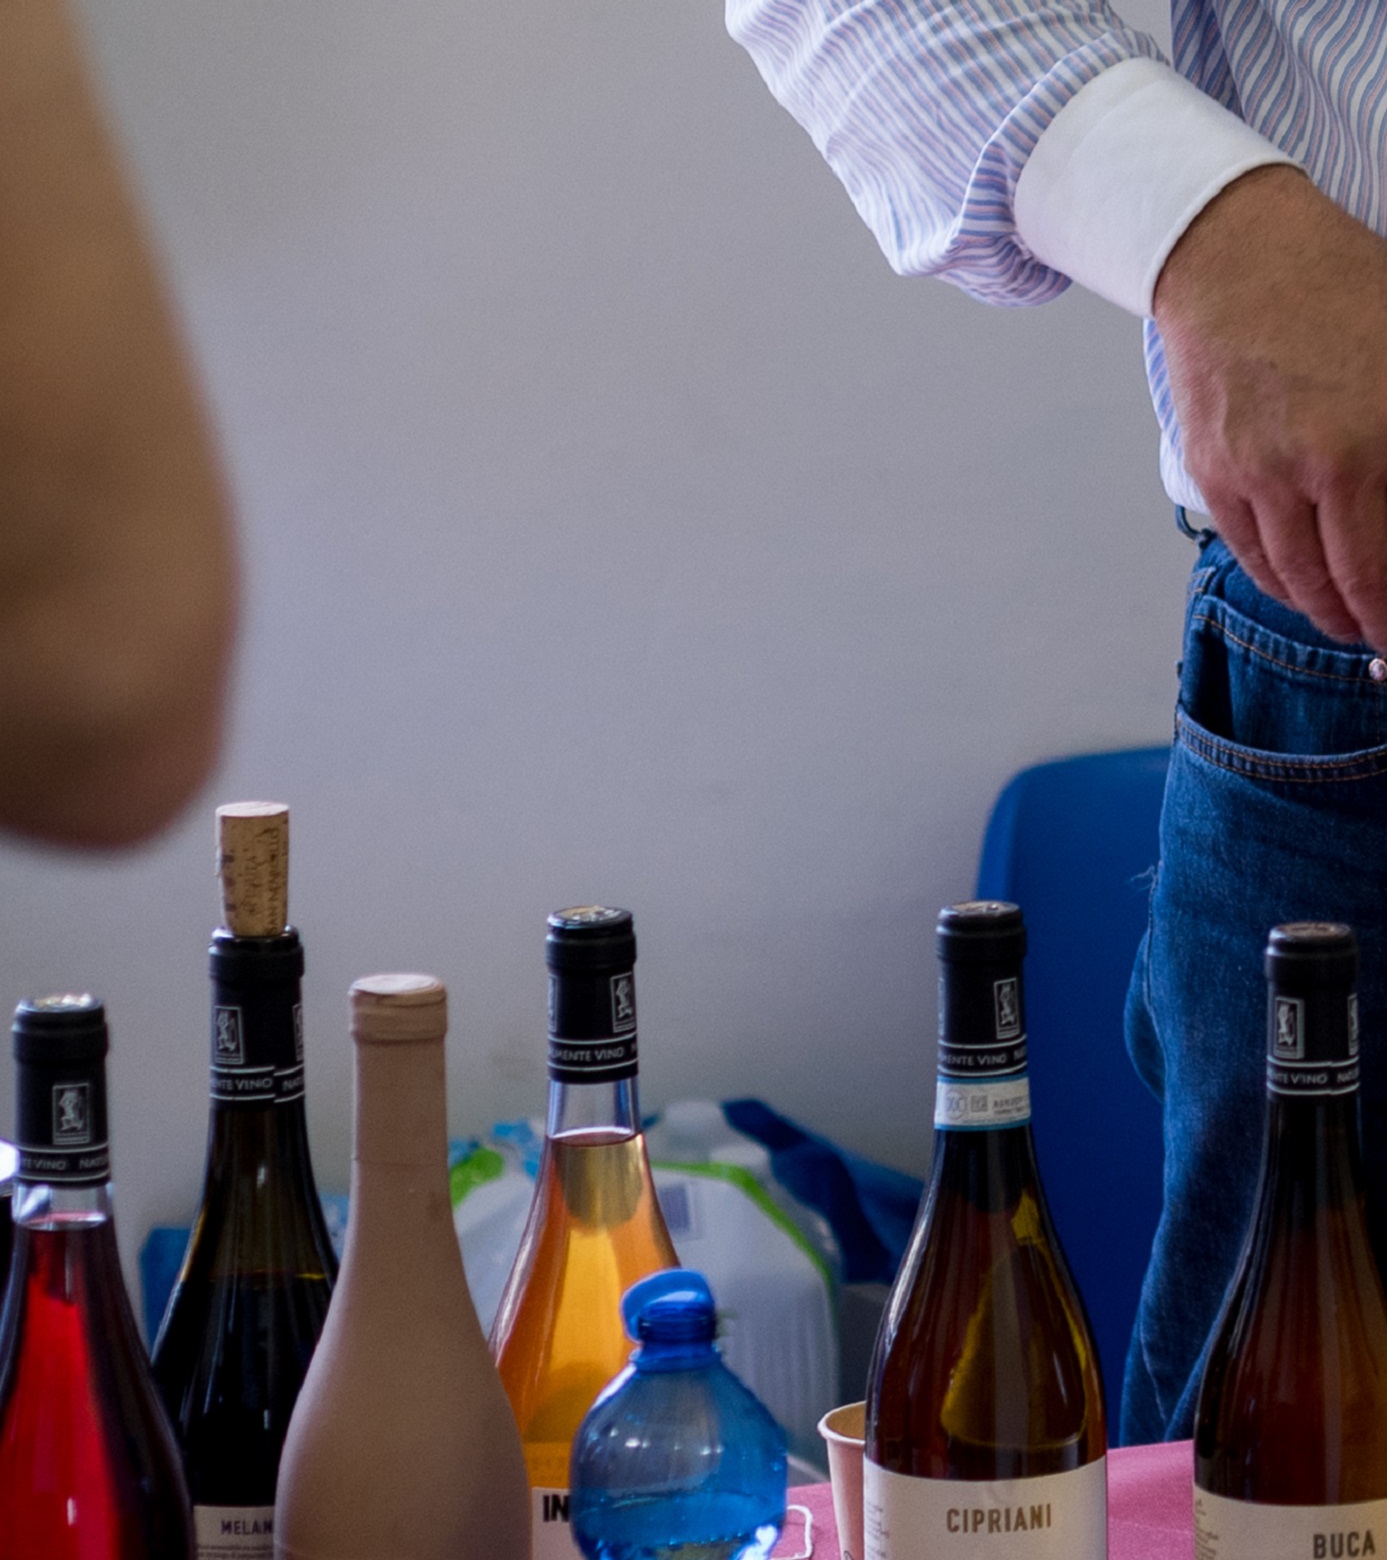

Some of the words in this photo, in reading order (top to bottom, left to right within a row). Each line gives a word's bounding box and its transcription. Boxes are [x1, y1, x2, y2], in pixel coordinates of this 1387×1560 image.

[235, 1077, 273, 1090] VINO
[946, 1503, 1053, 1534] CIPRIANI
[1312, 1529, 1377, 1560] BUCA
